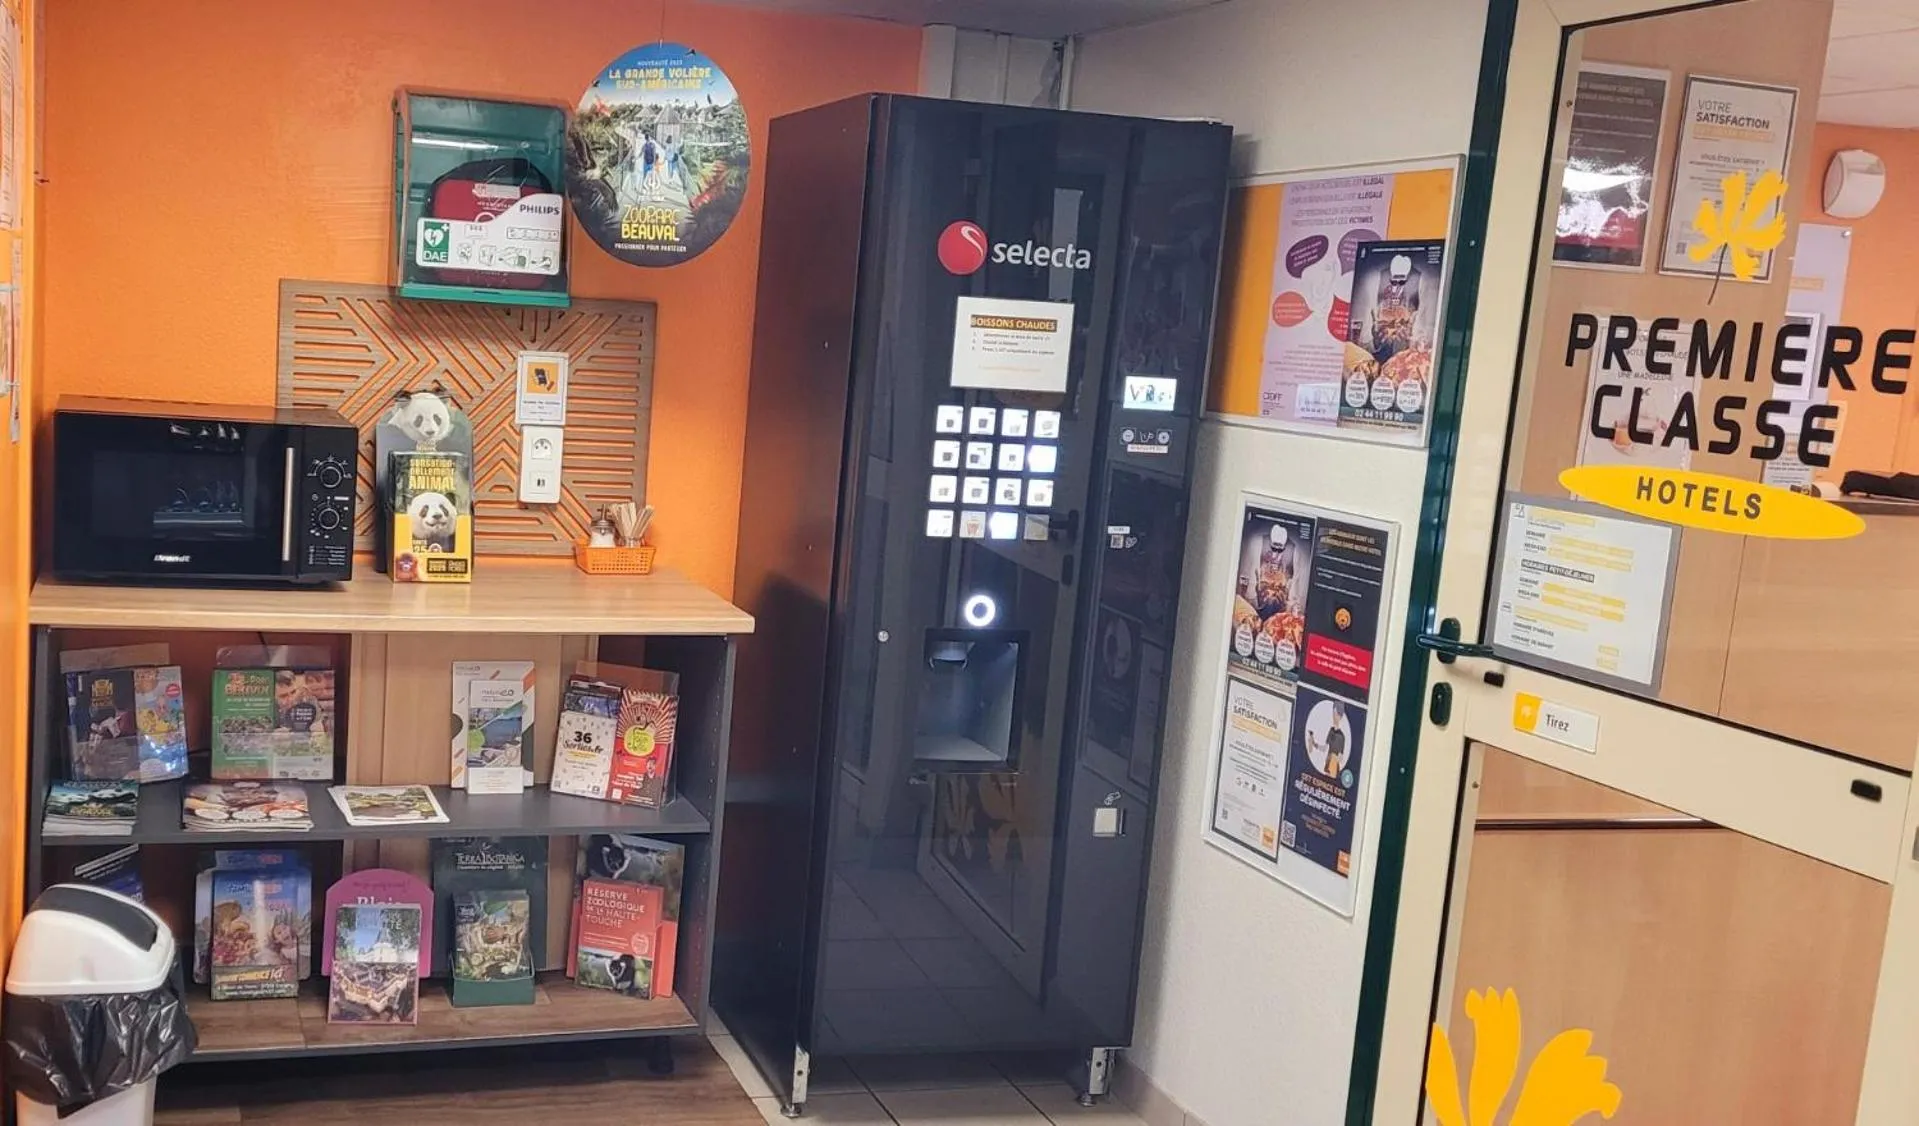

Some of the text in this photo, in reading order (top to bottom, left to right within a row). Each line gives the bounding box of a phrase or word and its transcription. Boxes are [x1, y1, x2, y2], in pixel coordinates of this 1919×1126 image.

[608, 65, 711, 79] LA GRANDE VOLIÈRE
[1698, 100, 1733, 113] VOTRE
[1696, 112, 1770, 130] SATISFACTION
[519, 203, 561, 216] PHILIPS
[622, 204, 681, 225] ZOOPARC
[621, 223, 681, 242] BEAUVAL
[423, 250, 449, 262] DAE
[991, 240, 1091, 269] selecta
[971, 316, 1056, 331] BOISSONS CHAUDES
[1565, 313, 1917, 395] PREMIERE
[1591, 384, 1839, 468] CLASSE
[408, 475, 456, 491] ANIMAL
[1636, 476, 1762, 520] HOTELS
[1233, 705, 1278, 730] SATISFACTION
[1546, 714, 1570, 732] Tirez
[573, 731, 592, 744] 36
[586, 896, 646, 914] ZOOLOGIQUE
[585, 914, 623, 929] TOUCHE
